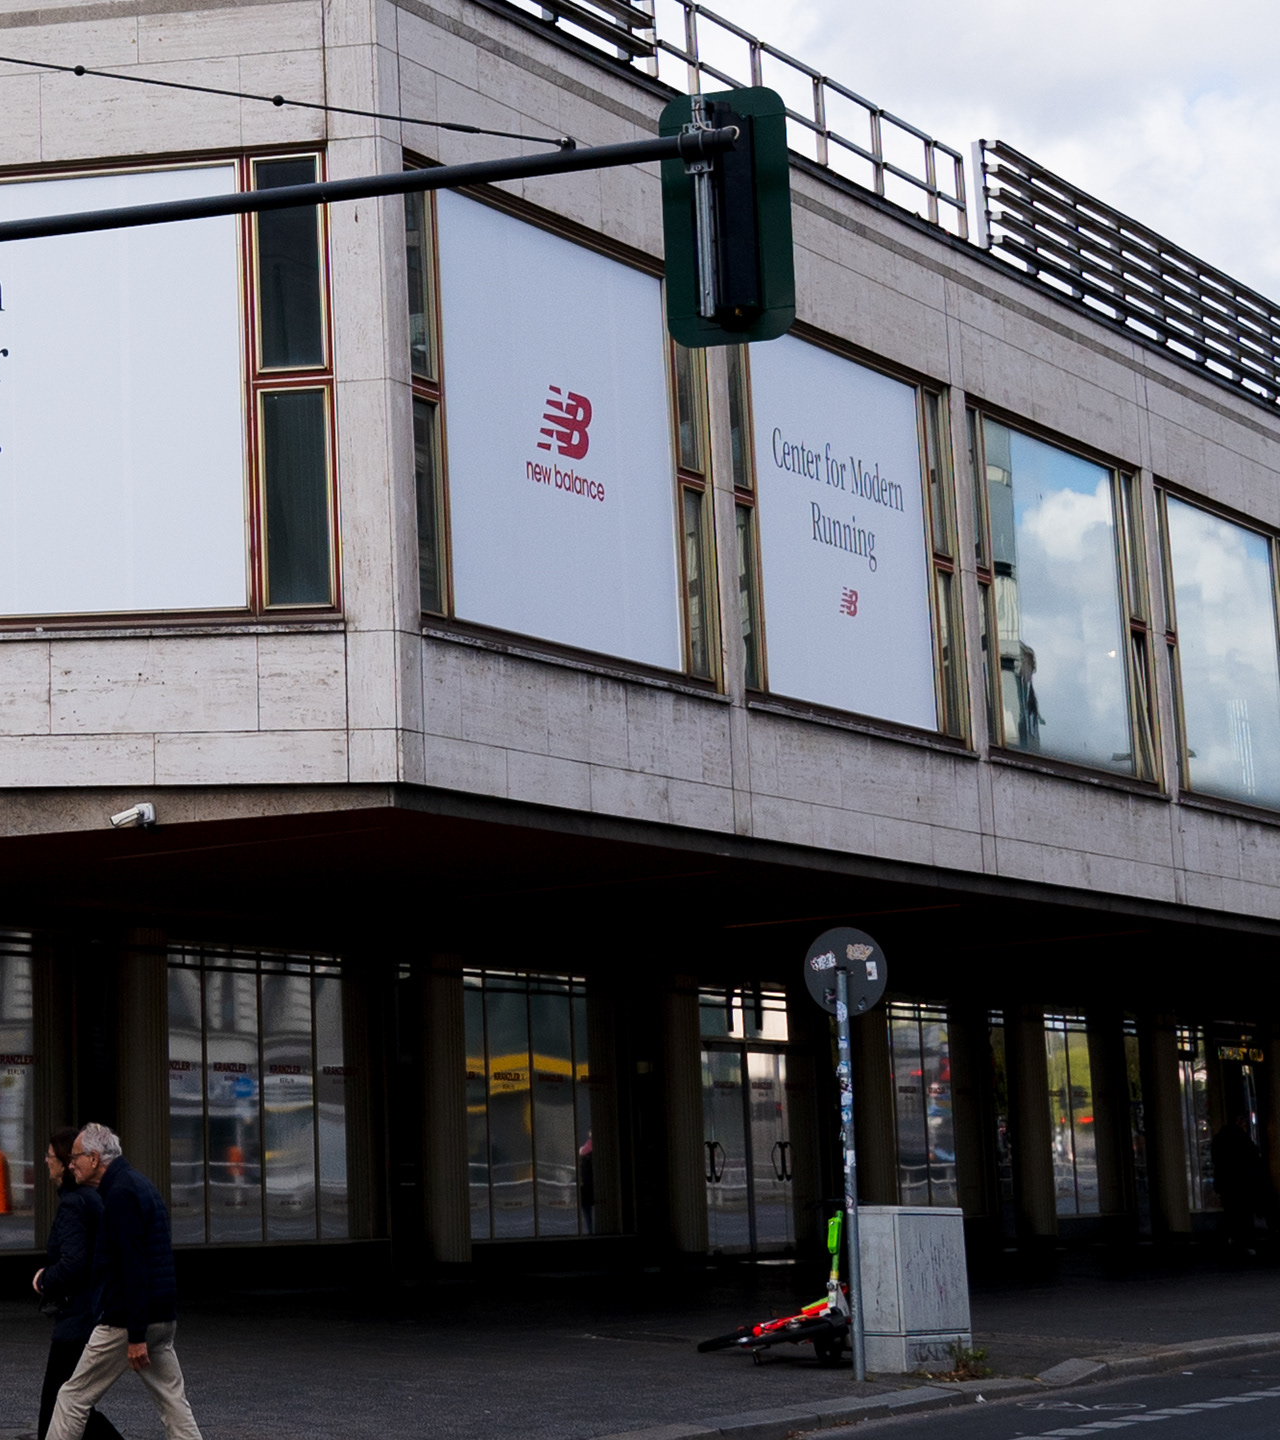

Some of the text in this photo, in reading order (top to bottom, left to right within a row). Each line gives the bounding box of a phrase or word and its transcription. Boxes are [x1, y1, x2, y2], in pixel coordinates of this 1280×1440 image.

[526, 461, 605, 502] new balance
[772, 427, 904, 512] Center for Modern
[810, 501, 878, 572] Running
[213, 1062, 247, 1073] KRANZLER
